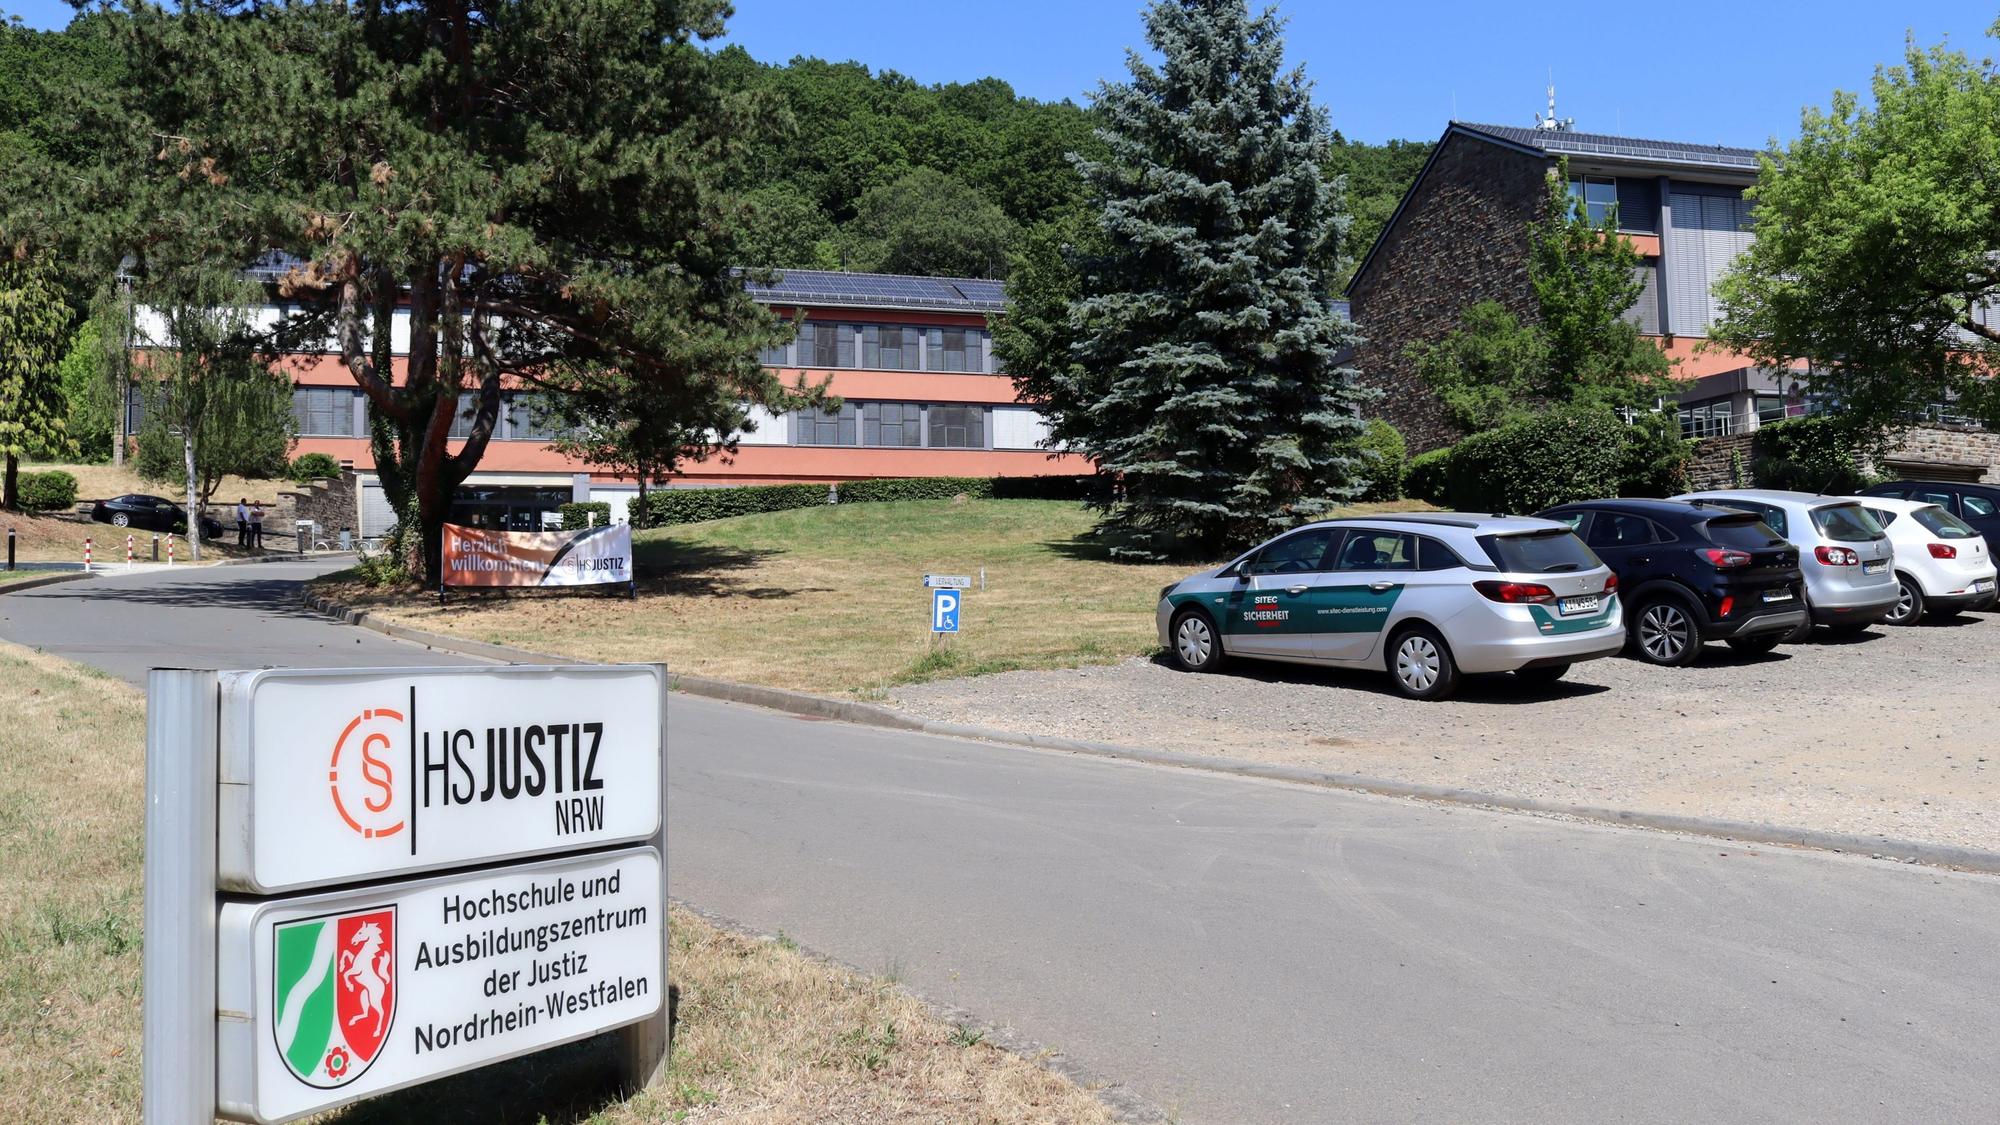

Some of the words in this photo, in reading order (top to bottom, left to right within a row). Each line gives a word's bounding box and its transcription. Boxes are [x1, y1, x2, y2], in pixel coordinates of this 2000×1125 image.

[451, 537, 508, 554] Herzlich
[936, 594, 957, 628] P
[1243, 610, 1289, 621] SICHERHEIT
[1254, 595, 1278, 604] SITEC
[555, 795, 604, 836] NRW
[443, 877, 575, 925] Hochschule
[582, 868, 621, 899] und
[414, 906, 647, 971] Ausbildungszentrum
[483, 963, 521, 998] der
[527, 952, 588, 987] Justiz
[415, 976, 648, 1055] Nordrhein-Westfalen
